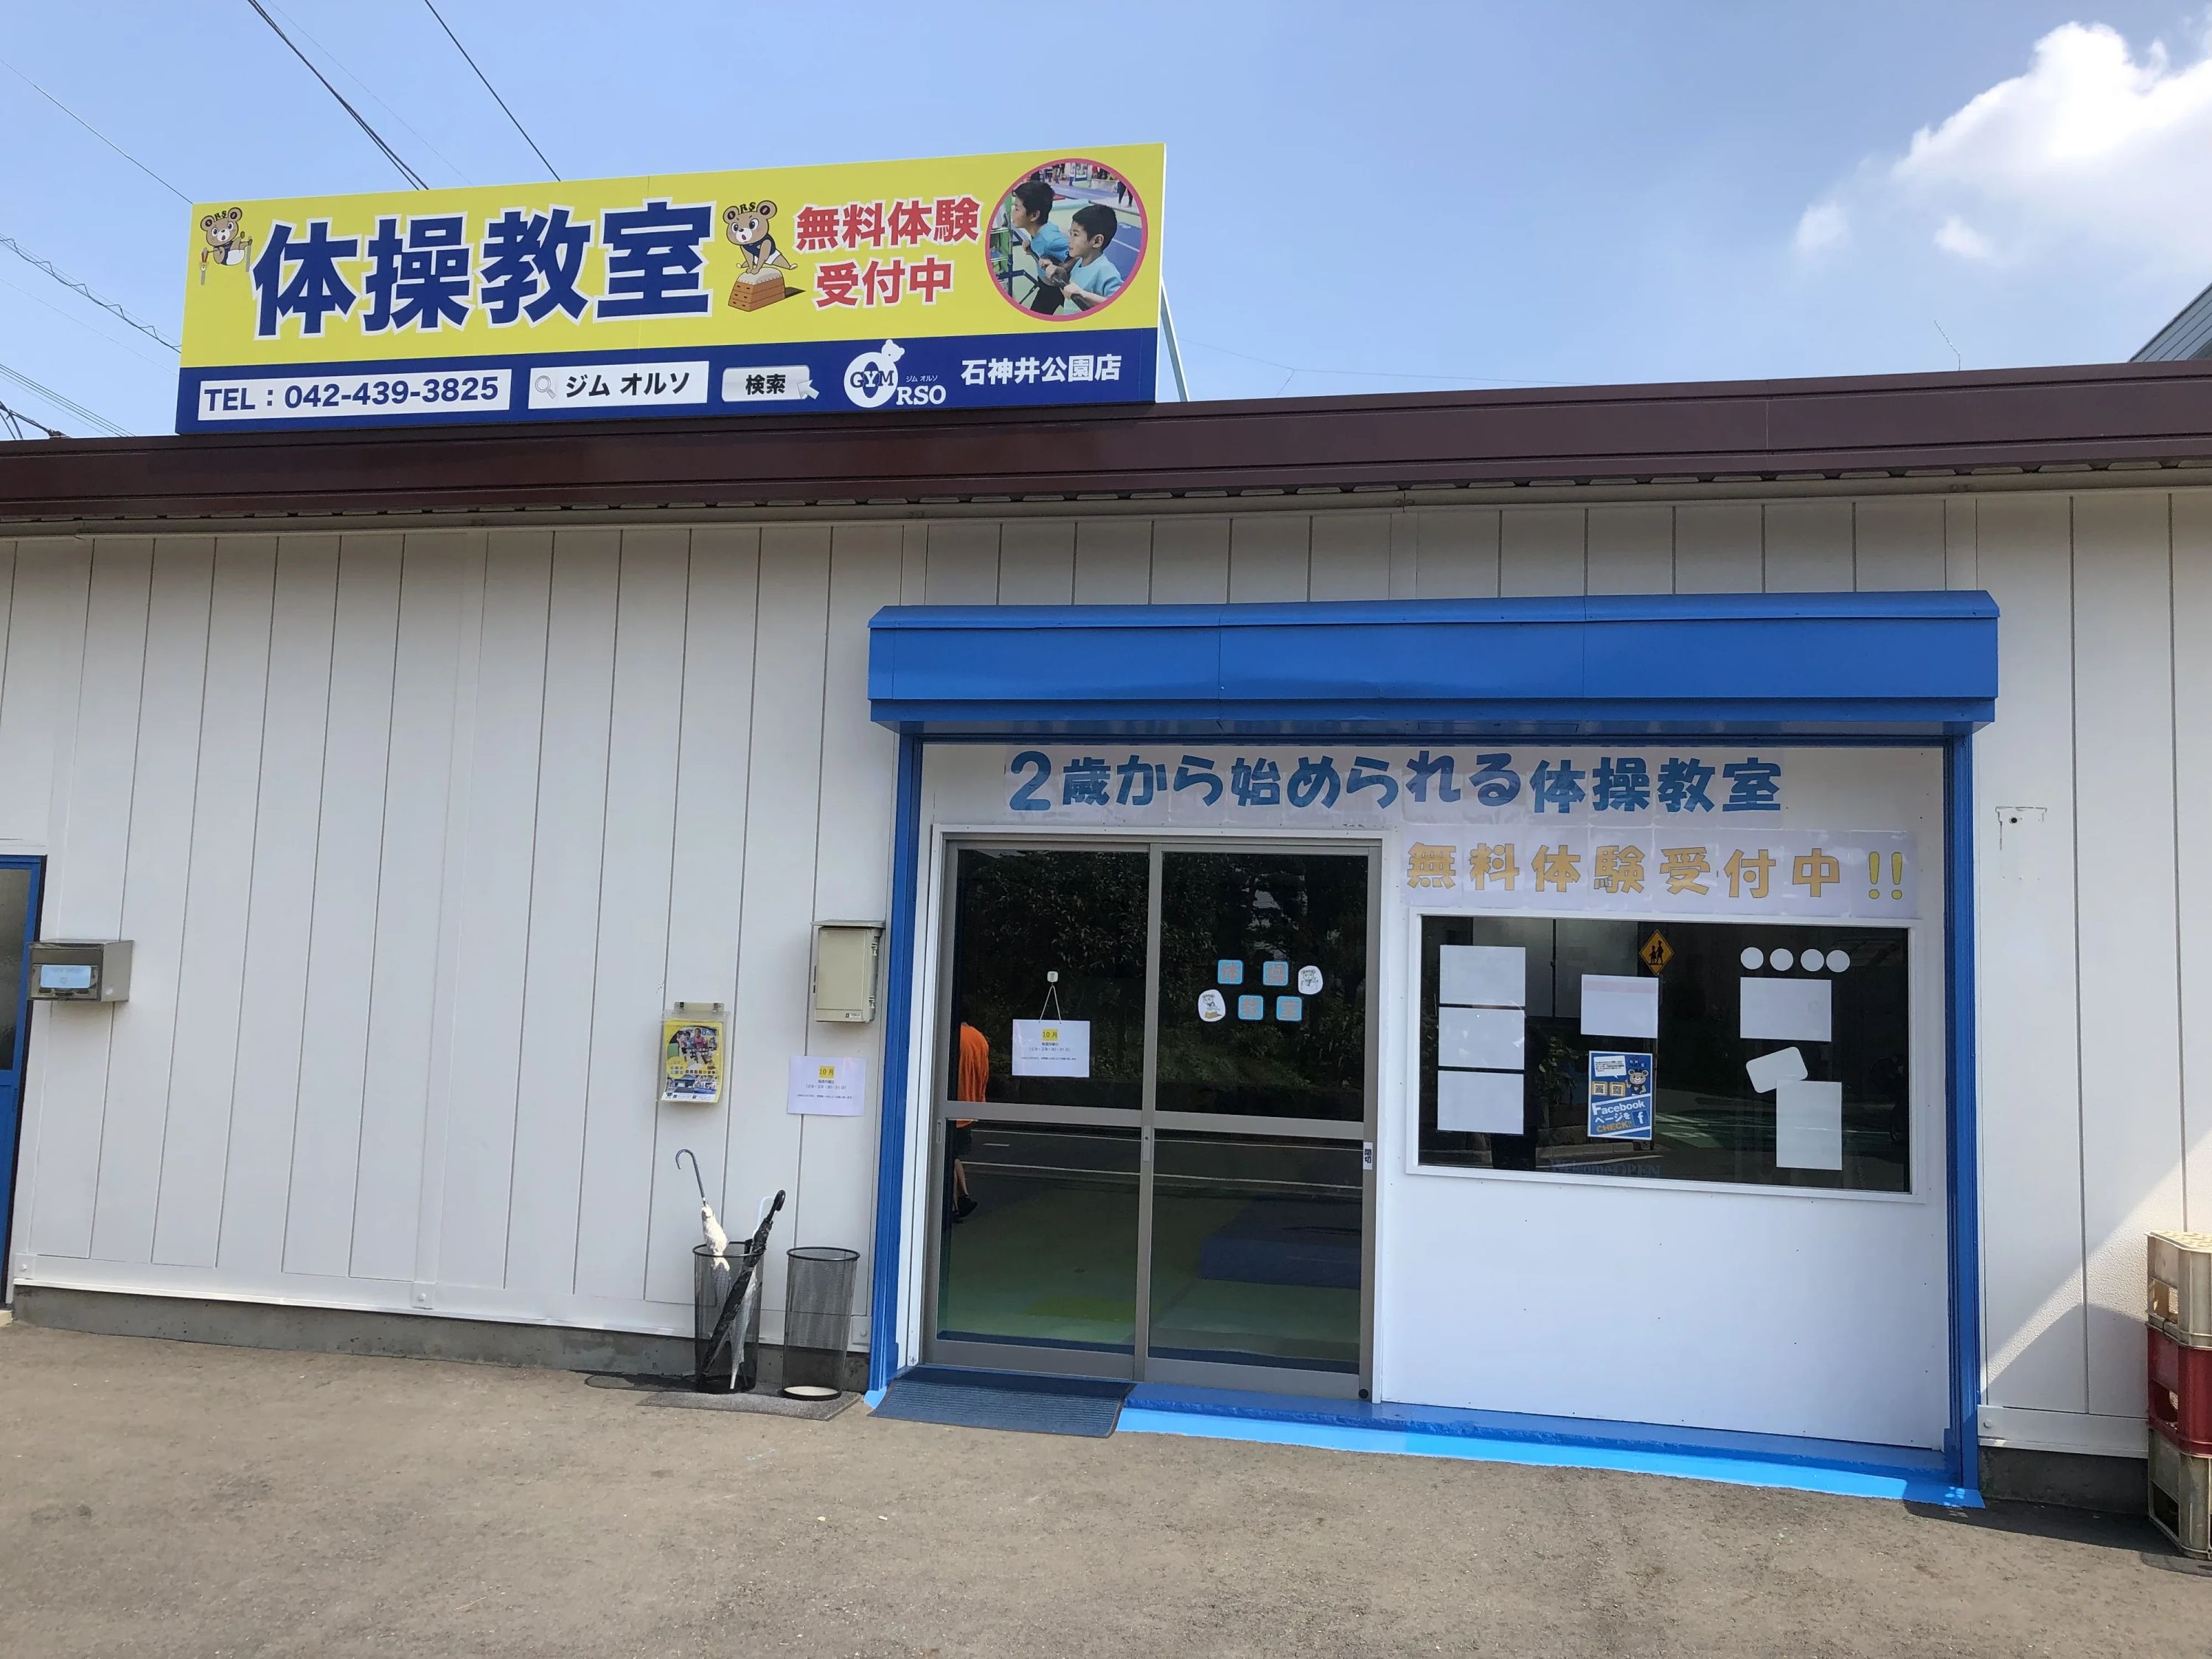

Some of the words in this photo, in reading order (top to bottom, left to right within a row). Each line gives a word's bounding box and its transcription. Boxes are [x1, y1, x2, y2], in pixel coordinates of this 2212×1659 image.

[796, 196, 980, 251] 無料体験
[252, 199, 713, 338] 体操教室
[816, 257, 953, 307] 受付中
[849, 370, 894, 389] GYM
[960, 353, 1122, 386] 石神井公園店
[565, 374, 611, 398] ジム
[620, 372, 690, 396] オルソ
[745, 373, 786, 396] 検索
[1009, 750, 1782, 814] 2歳から始められる体操教室
[1593, 1099, 1646, 1115] Facebook
[1595, 1112, 1631, 1124] ページを
